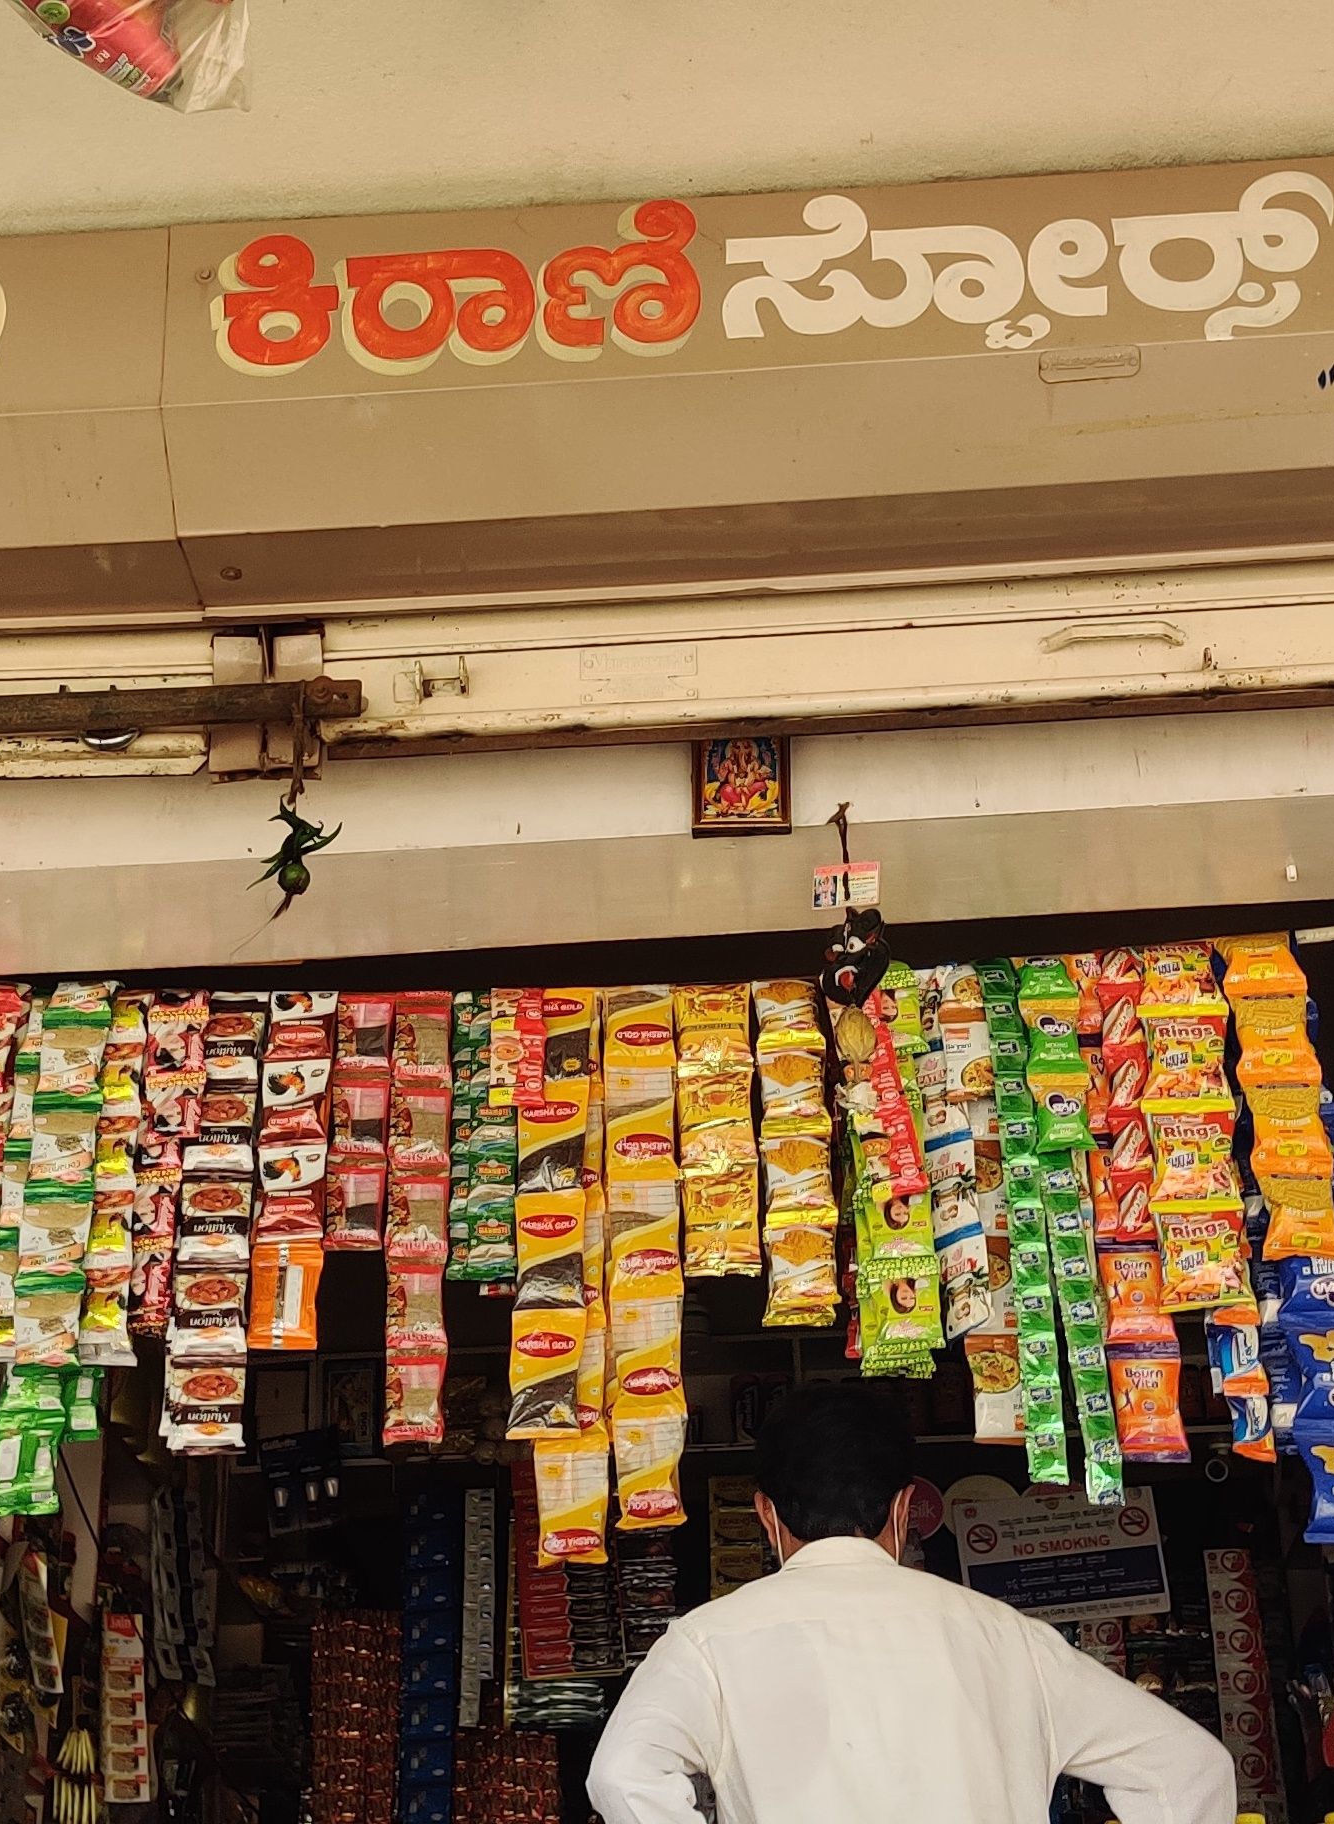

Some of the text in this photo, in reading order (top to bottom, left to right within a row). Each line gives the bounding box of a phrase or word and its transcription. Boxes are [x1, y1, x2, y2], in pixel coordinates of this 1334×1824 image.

[211, 200, 701, 376] ಕಿರಾಣಿ
[559, 1002, 583, 1011] GOLD
[616, 1031, 639, 1040] GOLD
[1158, 1025, 1213, 1039] Rings
[207, 1046, 245, 1057] Mutton
[523, 1106, 555, 1118] HARSHA
[556, 1105, 578, 1116] GOLD
[1163, 1124, 1219, 1138] Rings
[198, 1133, 240, 1144] Mutton
[615, 1142, 639, 1152] GOLD
[193, 1222, 236, 1235] Mutton
[520, 1219, 577, 1230] HARSHA GOLD
[1170, 1222, 1228, 1238] Rings
[1114, 1260, 1152, 1270] Bourn
[1120, 1269, 1148, 1280] Vita
[189, 1316, 233, 1328] Mutton
[516, 1340, 574, 1350] HARSHA GOLD
[1124, 1367, 1164, 1378] Bourn
[1132, 1378, 1159, 1388] Vita
[187, 1411, 231, 1423] Mutton
[1012, 1535, 1111, 1556] NO SMOKING
